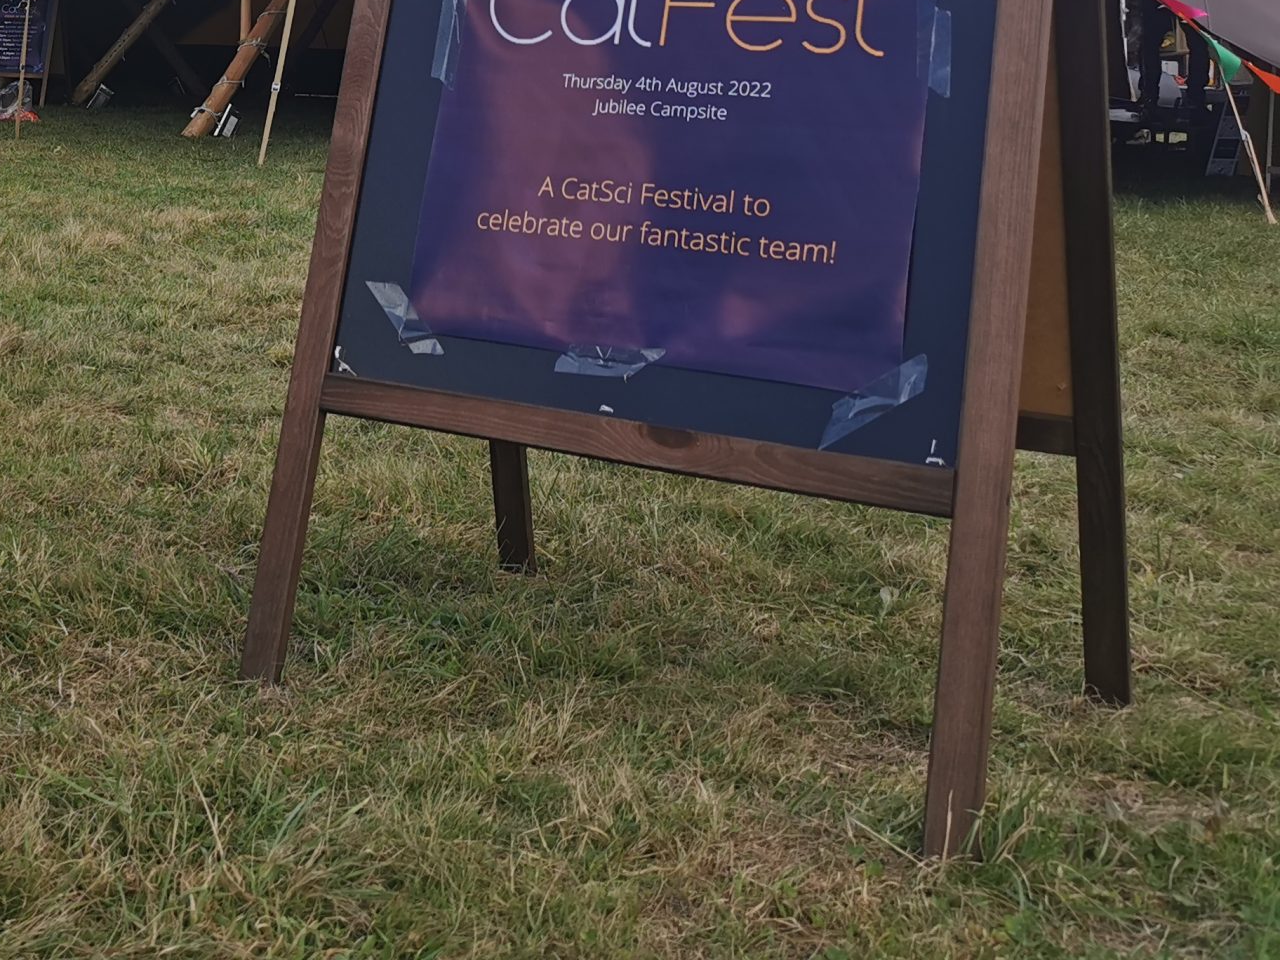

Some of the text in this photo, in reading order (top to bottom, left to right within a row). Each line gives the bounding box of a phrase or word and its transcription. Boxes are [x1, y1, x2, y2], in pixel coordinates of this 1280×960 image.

[562, 72, 772, 99] Thursday 4th August 2022
[592, 98, 728, 123] Jubilee Campsite
[537, 175, 771, 217] A CatSci Festival to
[477, 208, 837, 265] celebrate our fantastic team!
